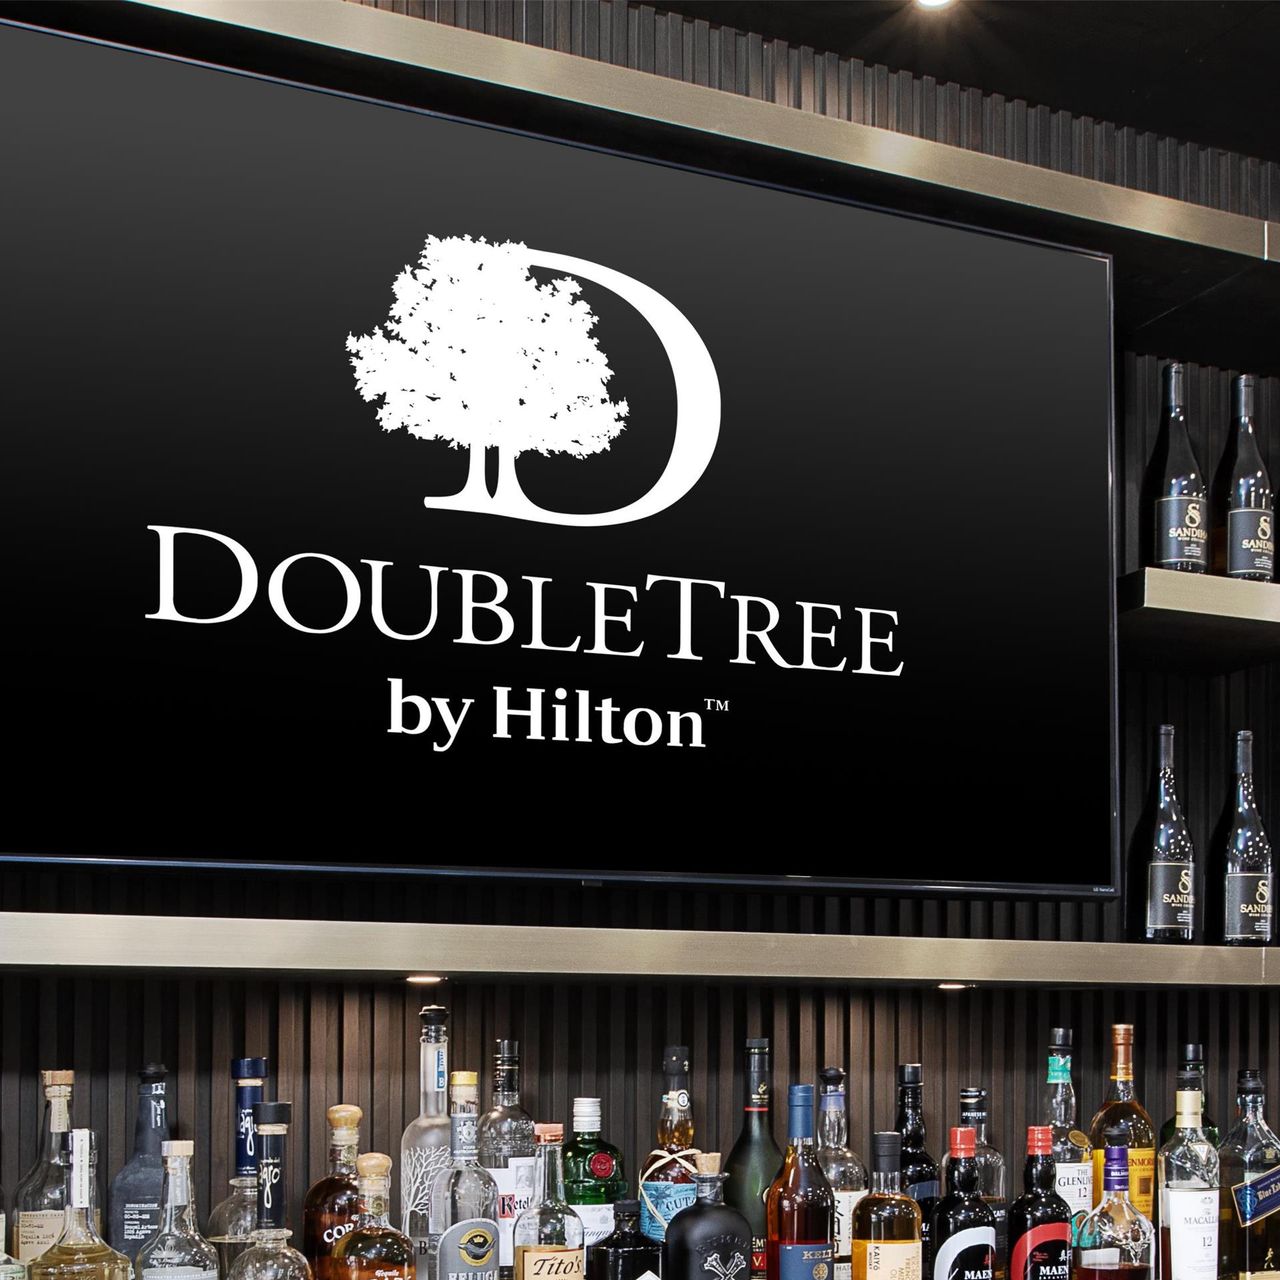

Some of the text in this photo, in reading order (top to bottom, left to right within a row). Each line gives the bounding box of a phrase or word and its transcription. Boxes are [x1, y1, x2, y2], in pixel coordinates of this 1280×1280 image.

[387, 677, 473, 753] by
[1078, 1187, 1088, 1198] 12
[1258, 1188, 1271, 1201] Blue
[1202, 1237, 1213, 1247] 12
